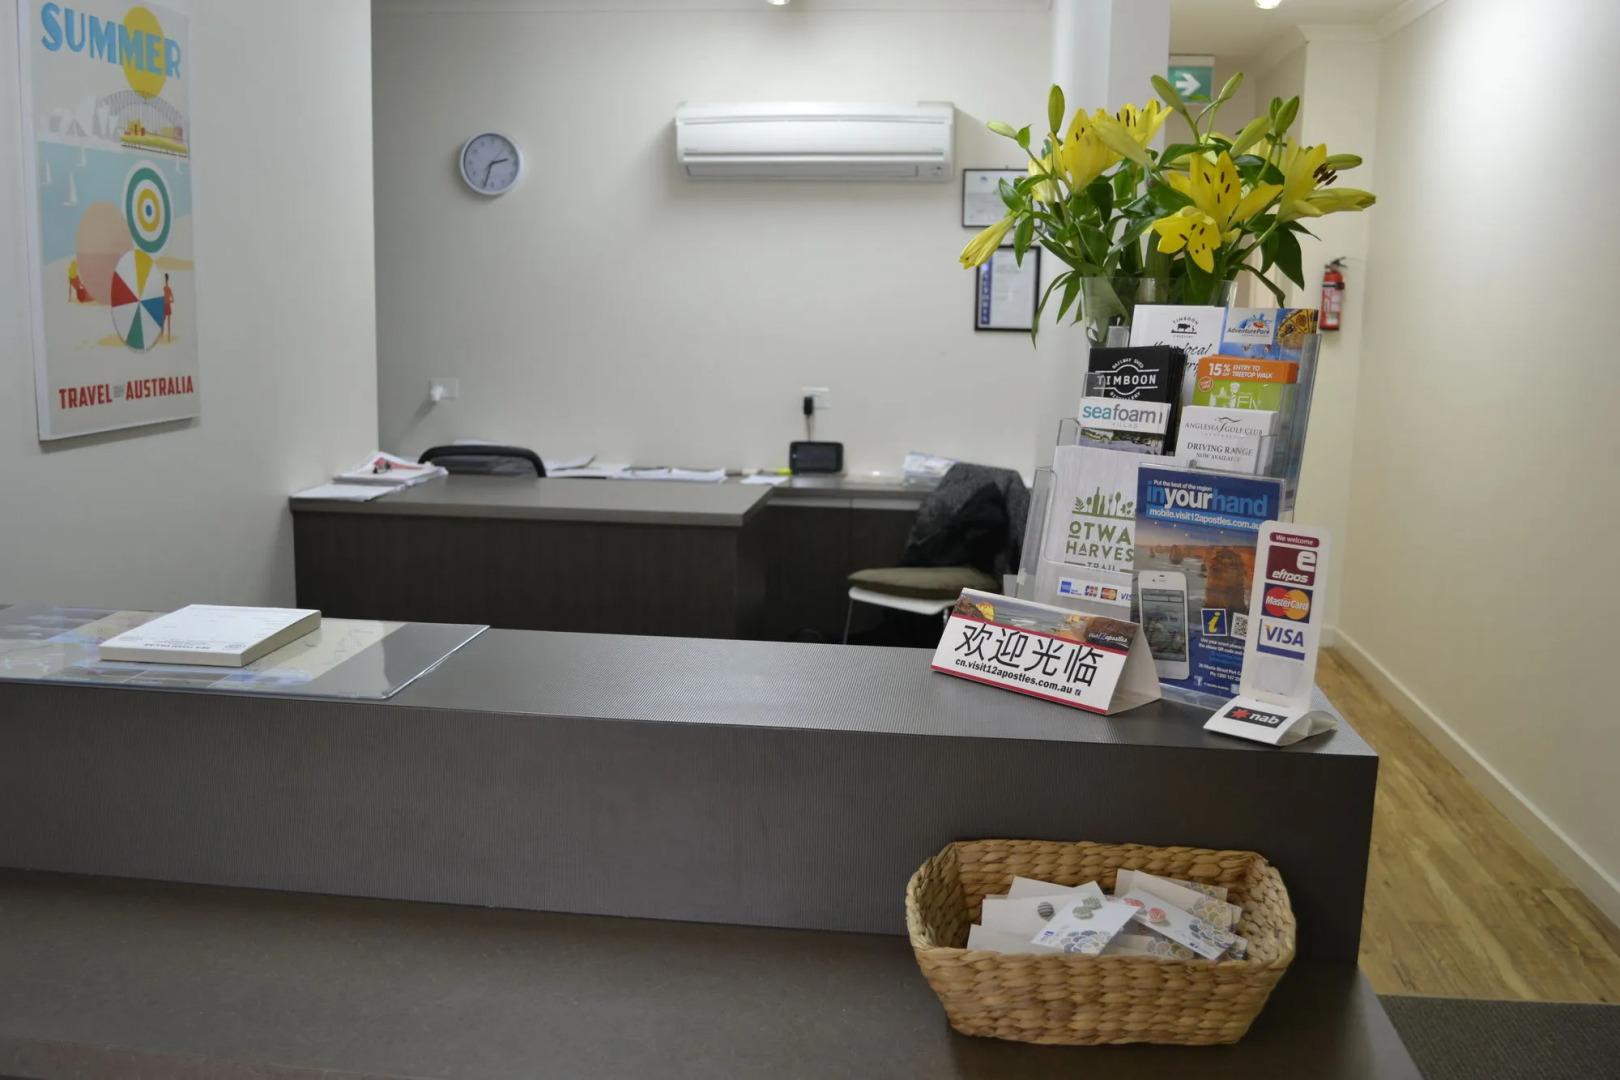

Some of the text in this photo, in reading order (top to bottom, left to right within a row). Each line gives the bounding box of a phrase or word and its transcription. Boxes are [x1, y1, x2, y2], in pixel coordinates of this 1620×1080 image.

[41, 2, 181, 79] SUMMER
[1096, 374, 1156, 386] TIMBOON
[59, 384, 112, 409] TRAVEL
[126, 376, 194, 400] AUSTRALIA
[1082, 404, 1156, 424] seafoam
[1185, 422, 1218, 431] ANGLESEA
[1244, 428, 1262, 436] CLUB
[1187, 442, 1254, 456] DRIVING RANGE
[1069, 520, 1131, 546] OTWA
[1275, 534, 1314, 546] We welcome
[1066, 541, 1134, 562] HARVES
[1272, 569, 1309, 584] eftpos
[1265, 595, 1309, 612] MasterCard
[1264, 624, 1304, 647] VISA
[954, 622, 1104, 687] 欢迎光临
[955, 656, 1073, 695] cn.visit12apostles.com.au
[1249, 713, 1280, 726] nab
